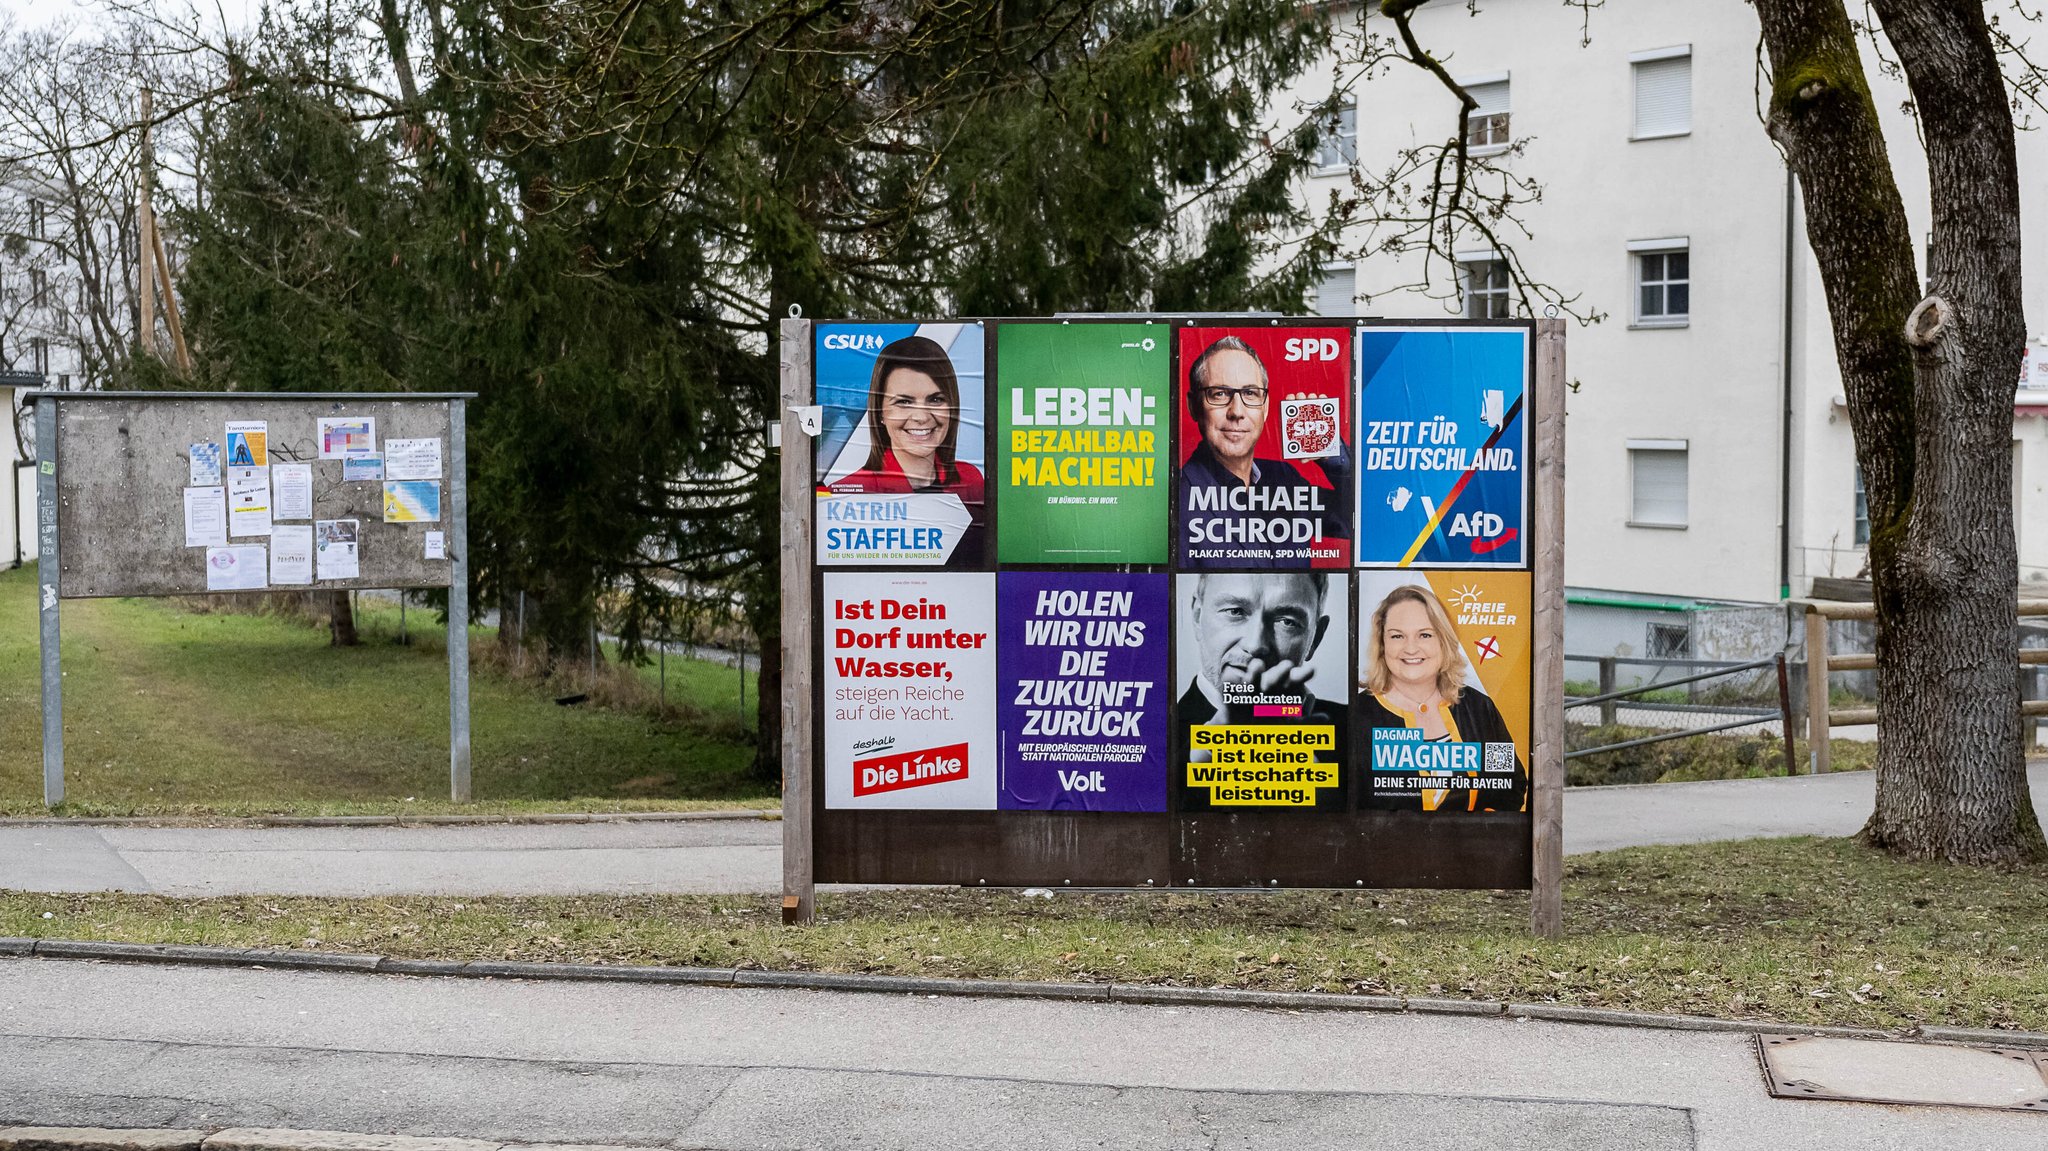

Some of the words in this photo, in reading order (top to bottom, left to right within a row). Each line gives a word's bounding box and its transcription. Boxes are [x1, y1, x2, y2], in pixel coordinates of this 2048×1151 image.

[823, 335, 864, 350] CSU
[1285, 338, 1339, 361] SPD
[1012, 388, 1155, 426] LEBEN:
[1294, 420, 1329, 437] SPD
[1367, 421, 1413, 445] ZEIT
[1417, 415, 1457, 445] FÜR
[1012, 431, 1154, 453] BEZAHLBAR
[1367, 448, 1517, 471] DEUTSCHLAND.
[1012, 457, 1154, 486] MACHEN!
[1059, 496, 1087, 505] BÜNDNIS.
[1100, 496, 1118, 504] WORT.
[1189, 486, 1325, 511] MICHAEL
[827, 501, 907, 521] KATRIN
[1188, 518, 1322, 543] SCHRODI
[1448, 513, 1503, 537] AfD
[827, 528, 943, 550] STAFFLER
[1189, 550, 1223, 559] PLAKAT
[1226, 550, 1273, 559] SCANNEN,
[1275, 550, 1294, 559] SPD
[1296, 547, 1339, 559] WÄHLEN!
[835, 599, 874, 620] Ist
[880, 599, 946, 620] Dein
[1036, 590, 1133, 617] HOLEN
[1463, 603, 1505, 613] FREIE
[1457, 612, 1516, 625] WÄHLER
[835, 627, 901, 649] Dorf
[907, 630, 986, 649] unter
[1025, 621, 1081, 646] WIR
[1085, 621, 1146, 647] UNS
[835, 657, 953, 682] Wasser,
[1059, 651, 1108, 676] DIE
[835, 687, 899, 703] steigen
[905, 686, 964, 701] Reiche
[1014, 680, 1153, 707] ZUKUNFT
[1223, 681, 1254, 693] Freie
[1223, 692, 1302, 704] Demokraten
[835, 705, 864, 721] auf
[869, 705, 896, 721] die
[901, 705, 954, 721] Yacht.
[1022, 705, 1144, 736] ZURÜCK
[853, 735, 895, 750] deshalb
[1196, 730, 1330, 745] Schönreden
[1374, 730, 1420, 741] DAGMAR
[1018, 743, 1034, 752] MIT
[1035, 742, 1100, 753] EUROPÄISCHEN
[1101, 742, 1146, 754] LÖSUNGEN
[1022, 753, 1048, 761] STATT
[1048, 753, 1102, 762] NATIONALEN
[1103, 754, 1142, 762] PAROLEN
[1217, 749, 1247, 763] ist
[1250, 749, 1308, 763] keine
[1374, 744, 1478, 769] WAGNER
[862, 766, 898, 788] Die
[902, 754, 961, 782] Linke
[1058, 771, 1106, 792] Volt
[1192, 768, 1333, 783] Wirtschafts-
[1374, 777, 1404, 788] DEINE
[1407, 777, 1448, 788] STIMME
[1451, 776, 1470, 789] FÜR
[1473, 777, 1512, 790] BAYERN
[1215, 786, 1310, 803] leistung.
